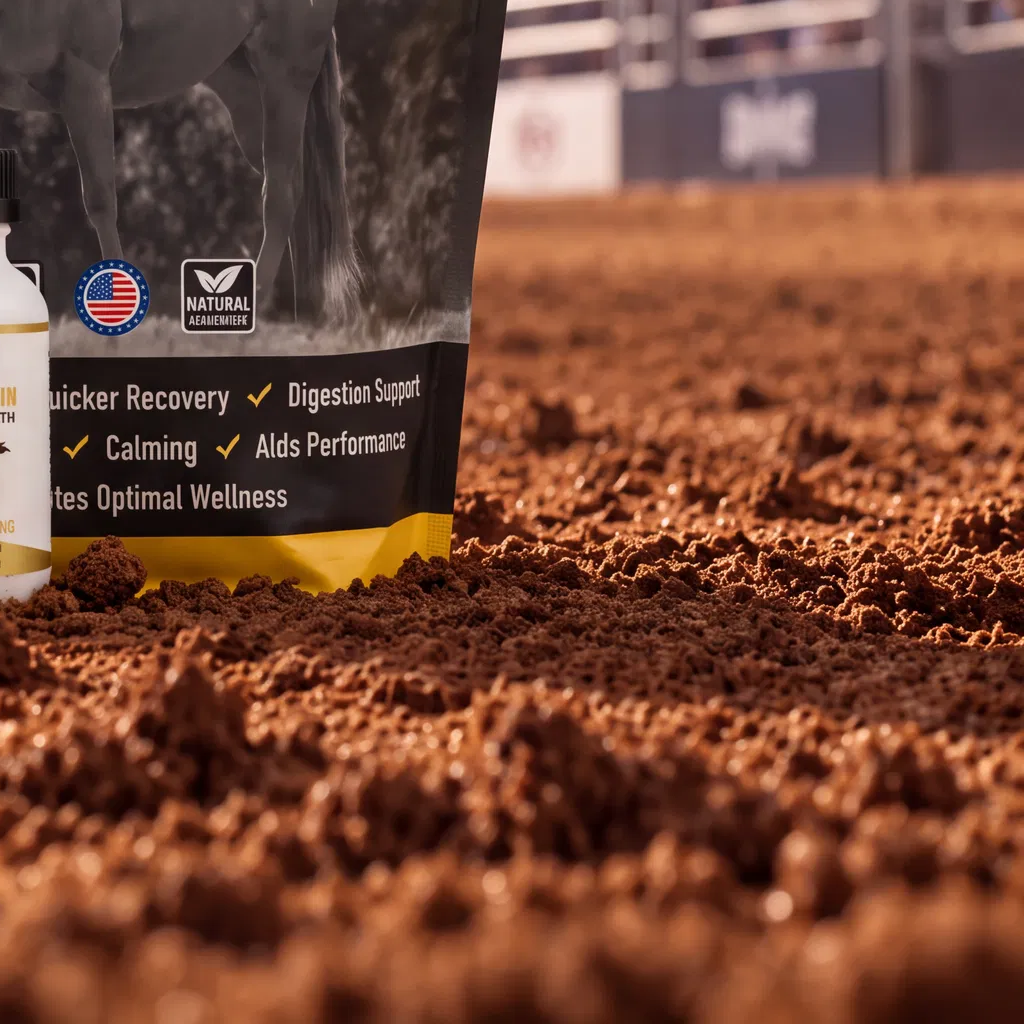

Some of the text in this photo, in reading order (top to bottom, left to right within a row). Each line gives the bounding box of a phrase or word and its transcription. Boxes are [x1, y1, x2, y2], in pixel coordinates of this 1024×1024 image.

[186, 296, 251, 312] NATURAL
[126, 384, 230, 416] Recovery
[288, 374, 421, 414] Digestion Support
[106, 434, 197, 468] Calming
[307, 429, 406, 457] Performance
[50, 482, 288, 518] tes Optimal Wellness
